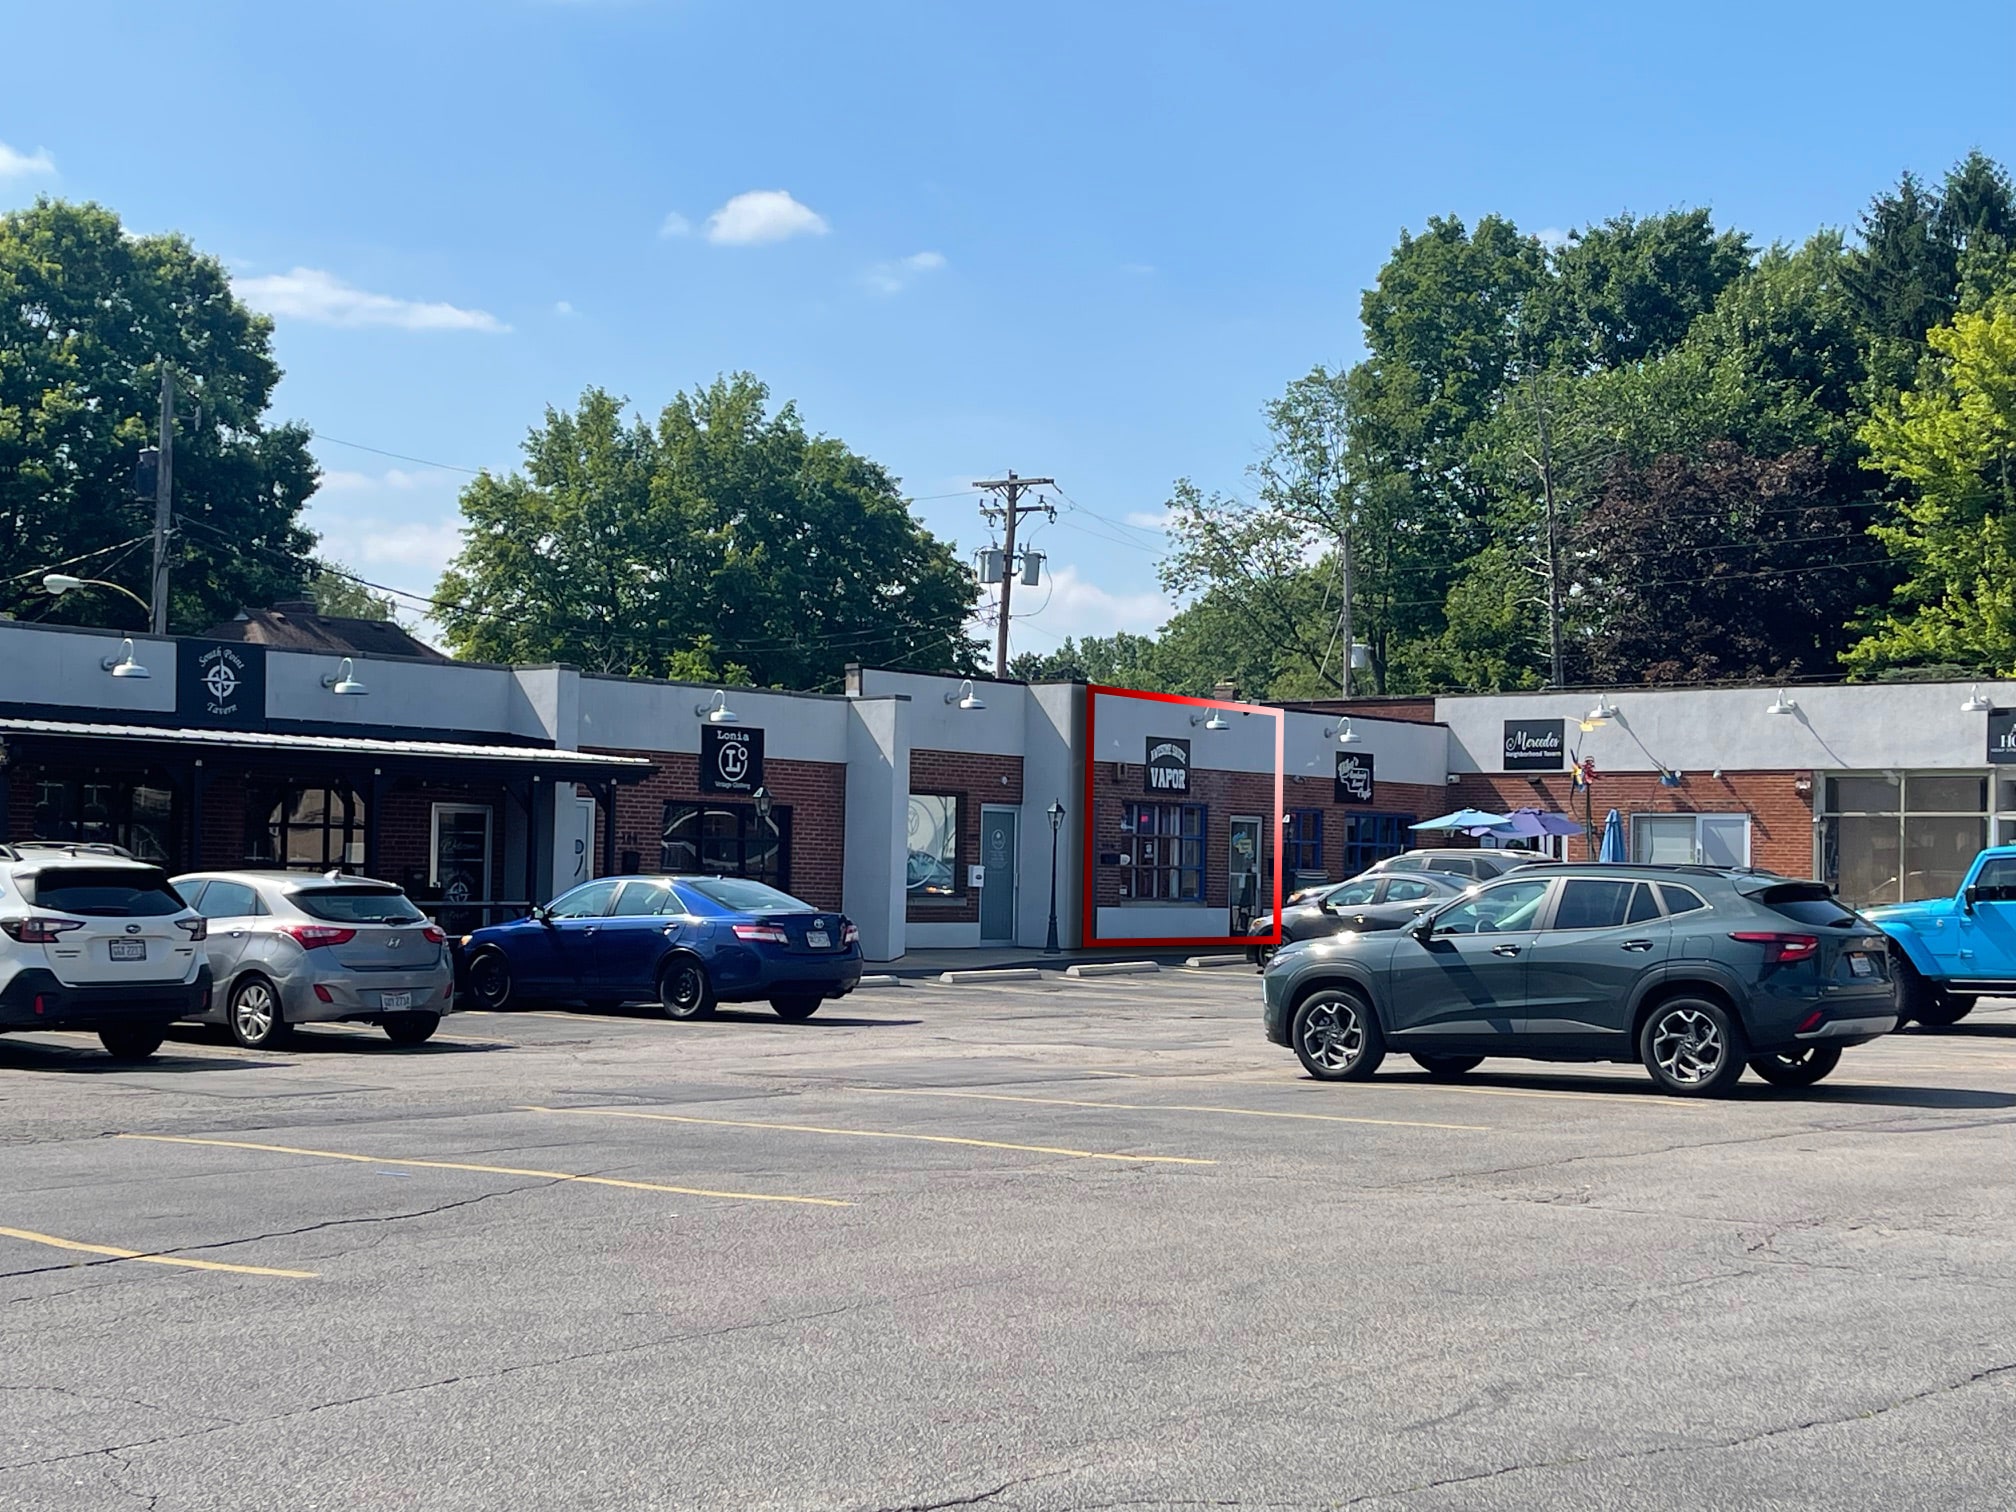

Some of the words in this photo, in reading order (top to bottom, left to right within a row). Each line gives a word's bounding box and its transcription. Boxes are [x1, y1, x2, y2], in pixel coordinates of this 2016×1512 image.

[207, 702, 238, 715] Tavern
[717, 730, 749, 741] Lonia
[1150, 767, 1186, 789] VAPOR
